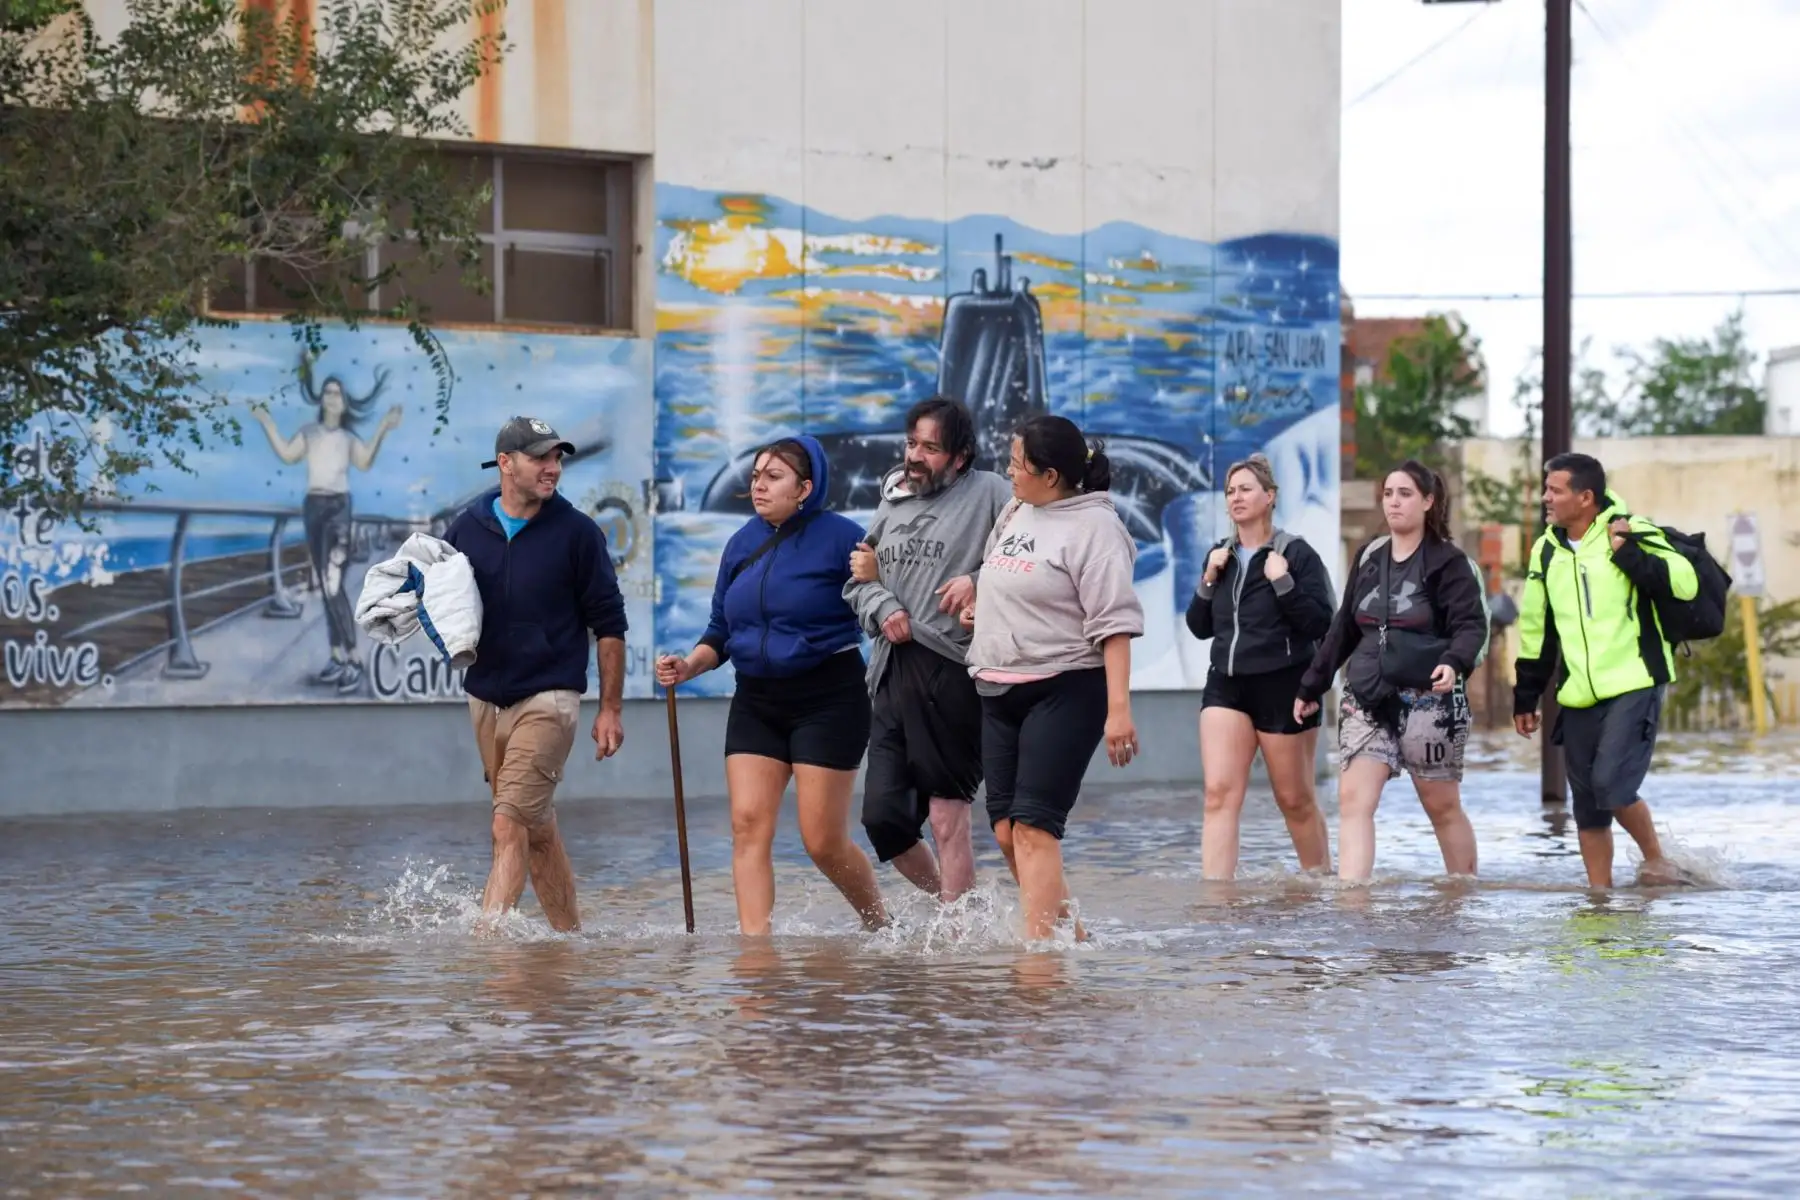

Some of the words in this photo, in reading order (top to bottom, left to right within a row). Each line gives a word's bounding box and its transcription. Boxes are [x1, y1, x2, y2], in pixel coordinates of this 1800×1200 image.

[1293, 334, 1326, 370] JUAN
[3, 573, 58, 618] os.
[5, 631, 113, 686] vive.
[1424, 741, 1446, 764] 10
